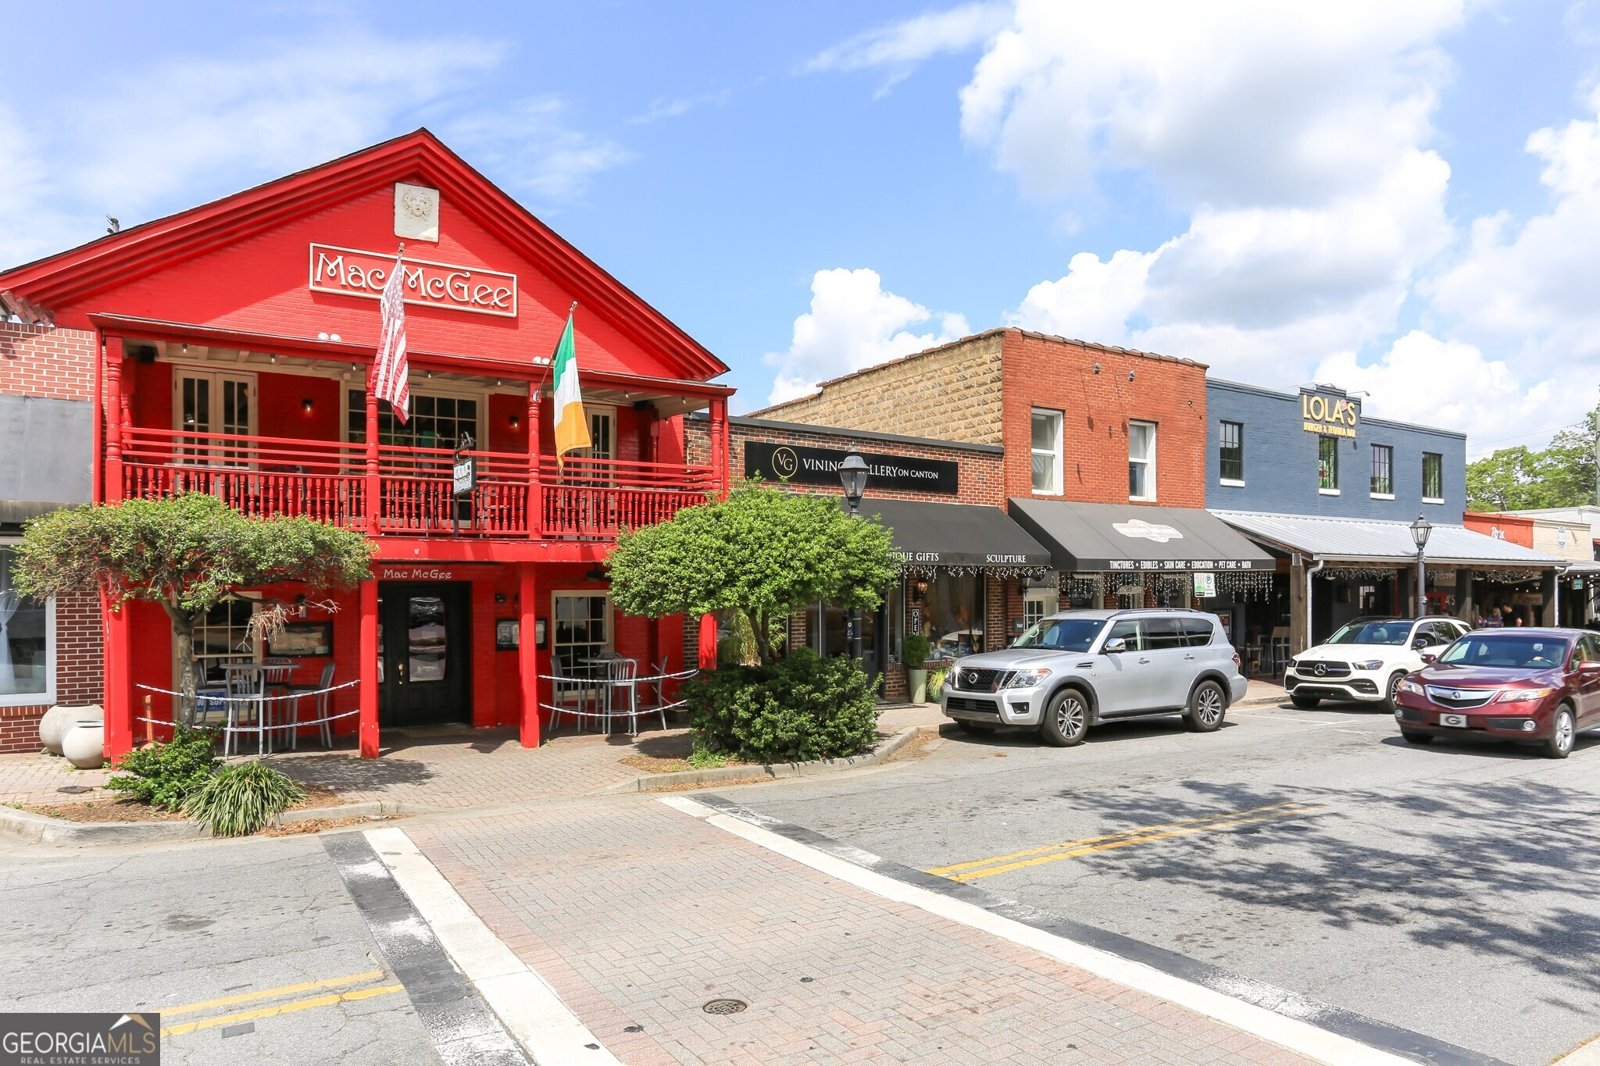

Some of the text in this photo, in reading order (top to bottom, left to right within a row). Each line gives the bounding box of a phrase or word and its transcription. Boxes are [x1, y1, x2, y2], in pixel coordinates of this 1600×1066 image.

[315, 252, 512, 308] Mac McGee
[1303, 394, 1356, 426] LOLA'S
[898, 466, 909, 477] ON
[910, 469, 939, 480] CANTON
[915, 552, 939, 562] GIFTS
[986, 554, 1026, 563] SCULPTURE
[1109, 560, 1135, 569] TINCTURES
[1140, 560, 1159, 569] EDIBLES
[1164, 560, 1174, 569] SKIN
[1175, 560, 1186, 569] CARE
[1191, 560, 1214, 569] EDUCATION
[1226, 560, 1237, 569] CARE
[1242, 560, 1252, 569] BATH
[383, 568, 452, 580] Mac McGee
